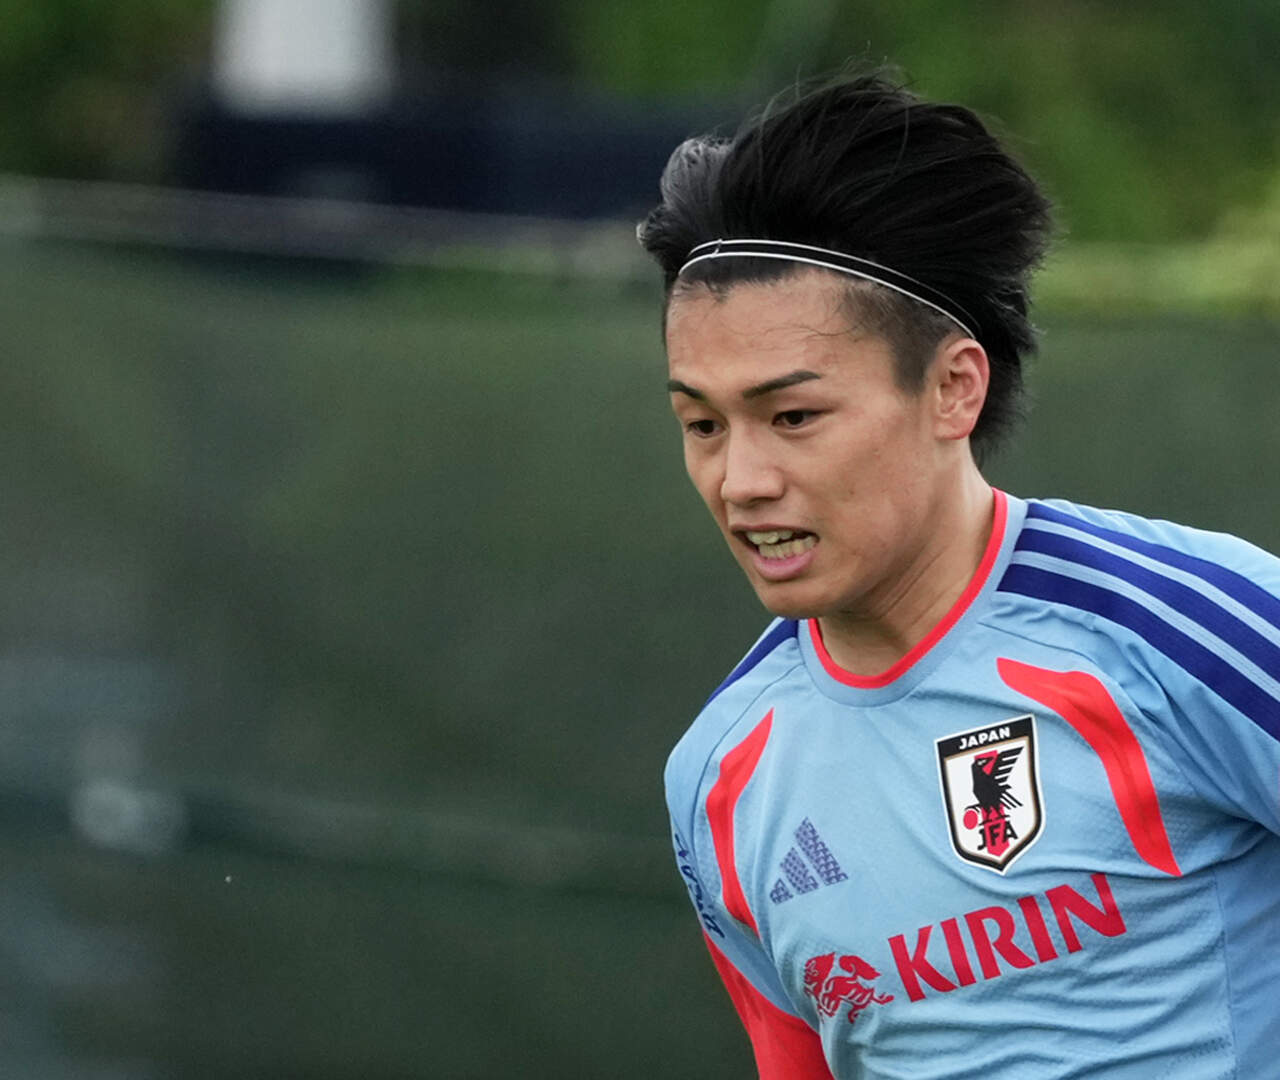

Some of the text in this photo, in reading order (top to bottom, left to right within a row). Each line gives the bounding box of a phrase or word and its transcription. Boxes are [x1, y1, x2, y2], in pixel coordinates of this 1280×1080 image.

[959, 726, 1011, 750] JAPAN
[977, 820, 1018, 850] JFA
[887, 872, 1127, 1003] KIRIN
